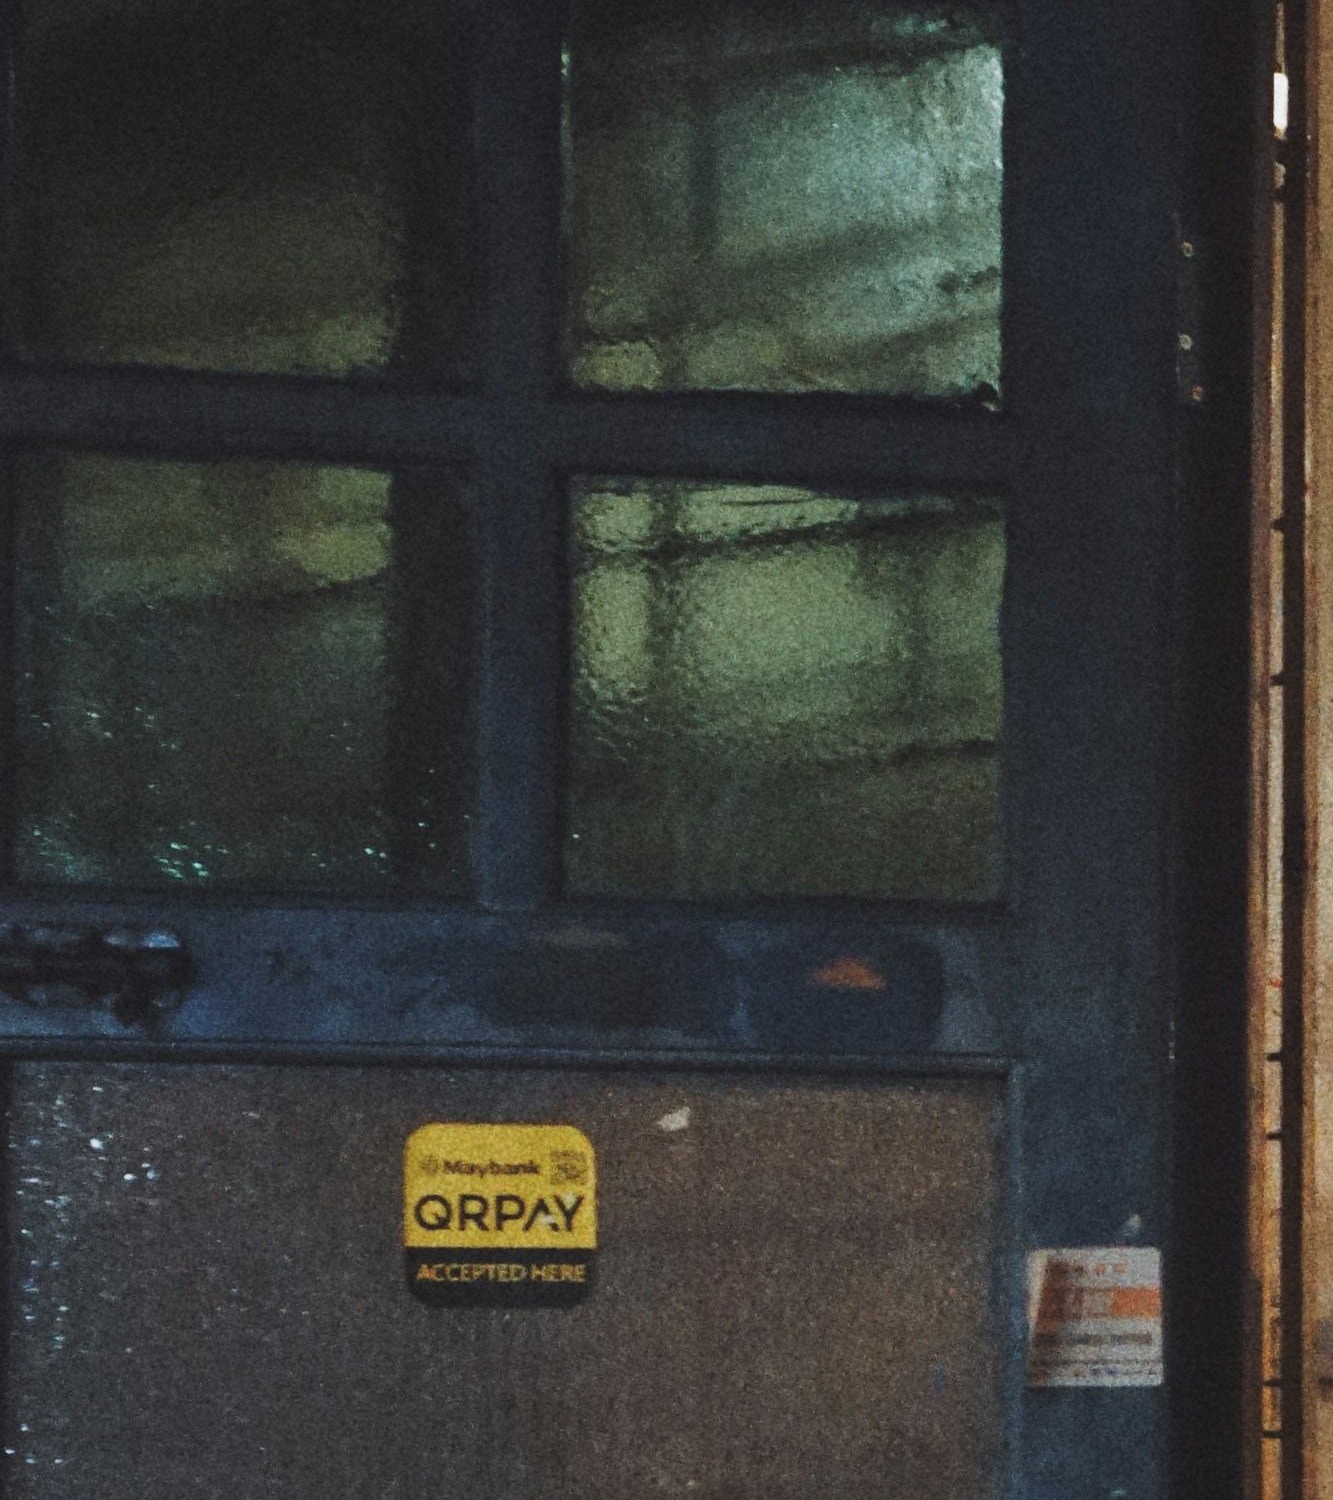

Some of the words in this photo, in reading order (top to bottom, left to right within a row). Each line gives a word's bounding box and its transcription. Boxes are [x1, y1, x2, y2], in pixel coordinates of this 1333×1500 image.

[443, 1160, 540, 1178] Maybank
[414, 1193, 585, 1232] QRPAY
[416, 1263, 527, 1282] ACCEPTED
[531, 1263, 587, 1283] HERE
